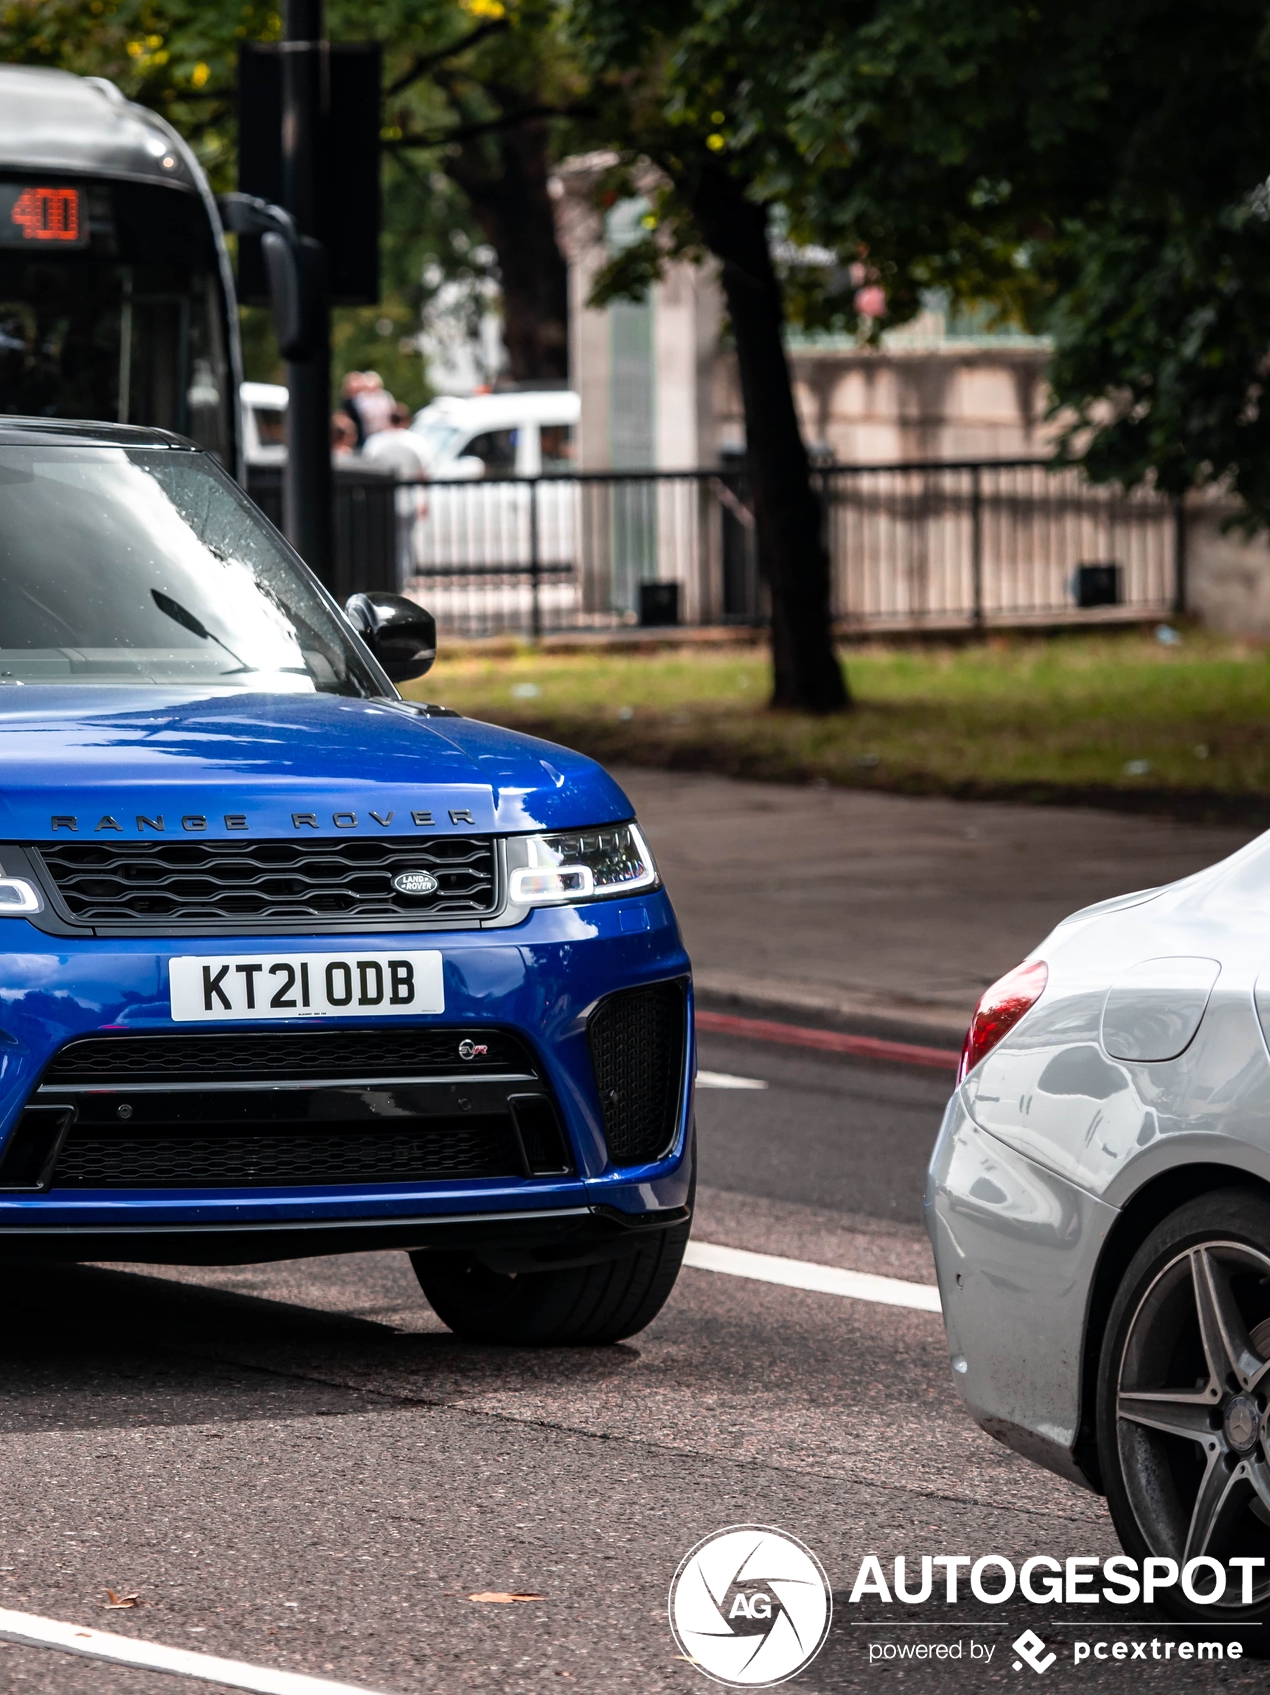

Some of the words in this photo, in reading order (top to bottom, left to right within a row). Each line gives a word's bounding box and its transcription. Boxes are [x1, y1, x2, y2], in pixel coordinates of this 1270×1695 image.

[51, 814, 249, 832] RANGE
[291, 808, 476, 829] ROVER
[402, 875, 424, 883] LAND
[405, 882, 432, 890] ROVER
[202, 962, 311, 1011] KT21
[325, 960, 415, 1007] ODB
